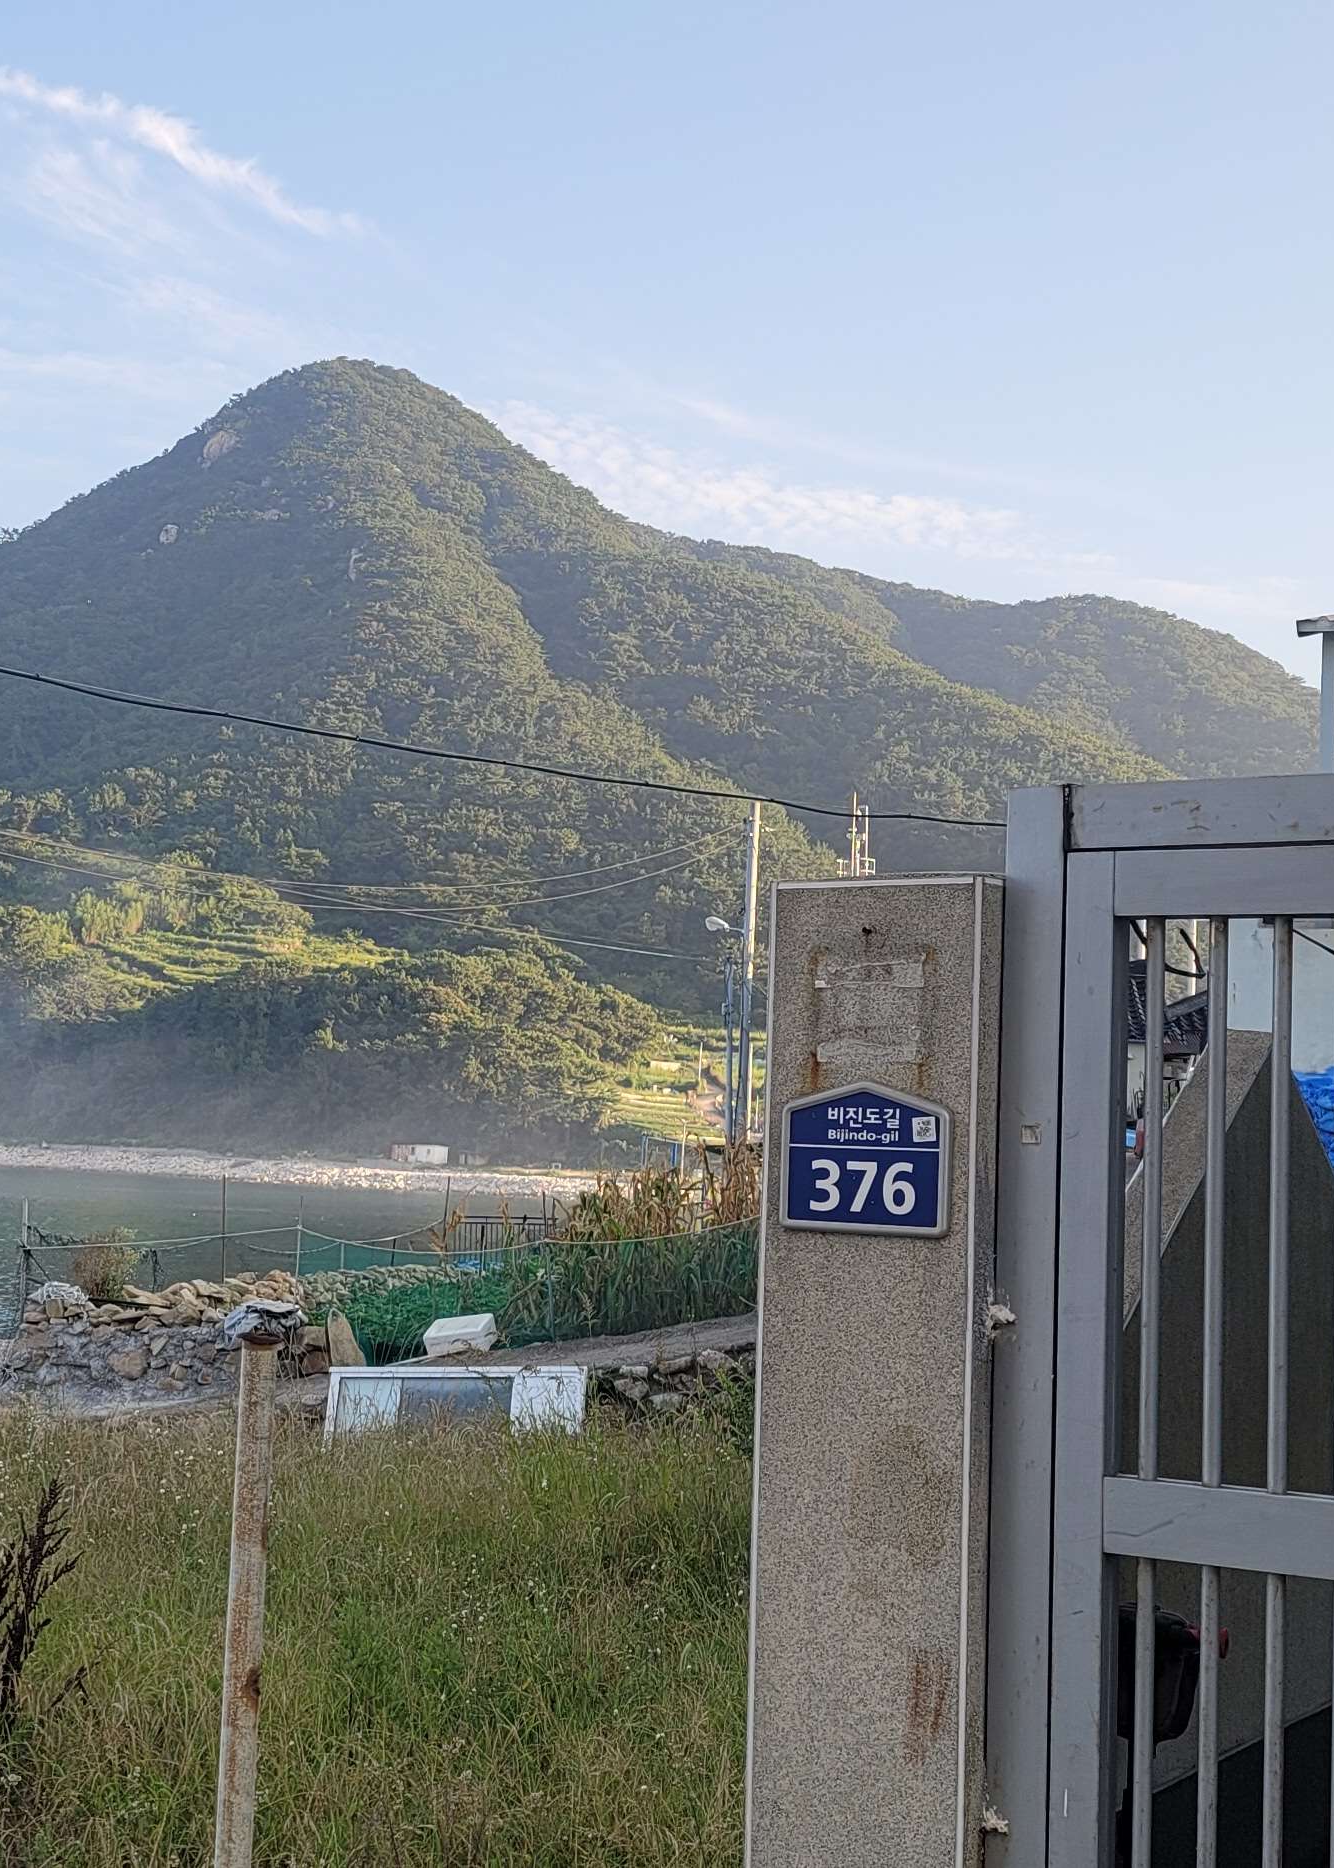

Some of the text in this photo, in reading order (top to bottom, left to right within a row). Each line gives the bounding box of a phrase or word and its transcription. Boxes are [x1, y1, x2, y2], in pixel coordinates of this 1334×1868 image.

[827, 1106, 901, 1130] 비진도길
[827, 1129, 899, 1144] Bijindo-gil
[808, 1158, 916, 1216] 376
